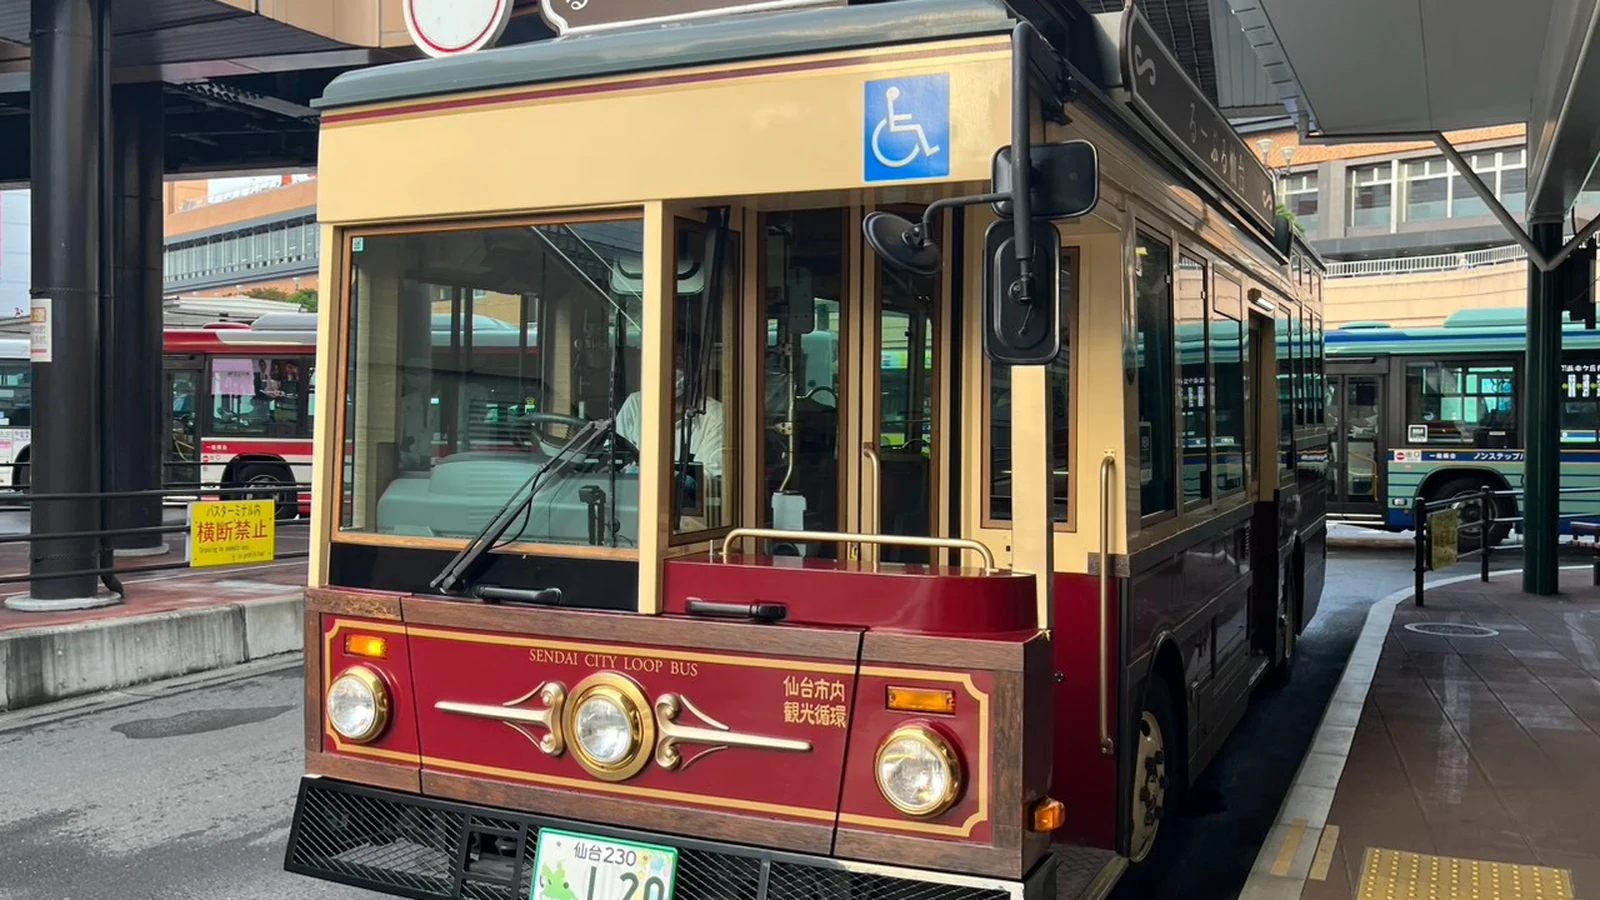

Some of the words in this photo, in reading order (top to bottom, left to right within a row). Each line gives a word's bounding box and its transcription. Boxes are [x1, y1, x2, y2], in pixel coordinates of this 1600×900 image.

[207, 504, 261, 517] バスターミナル内
[197, 519, 268, 543] 横断禁止
[529, 649, 578, 666] SENDAI
[585, 654, 617, 669] CITY
[624, 657, 663, 673] LOOP
[671, 662, 698, 677] BUS
[783, 675, 845, 702] 仙台市内
[783, 700, 846, 728] 観光循環
